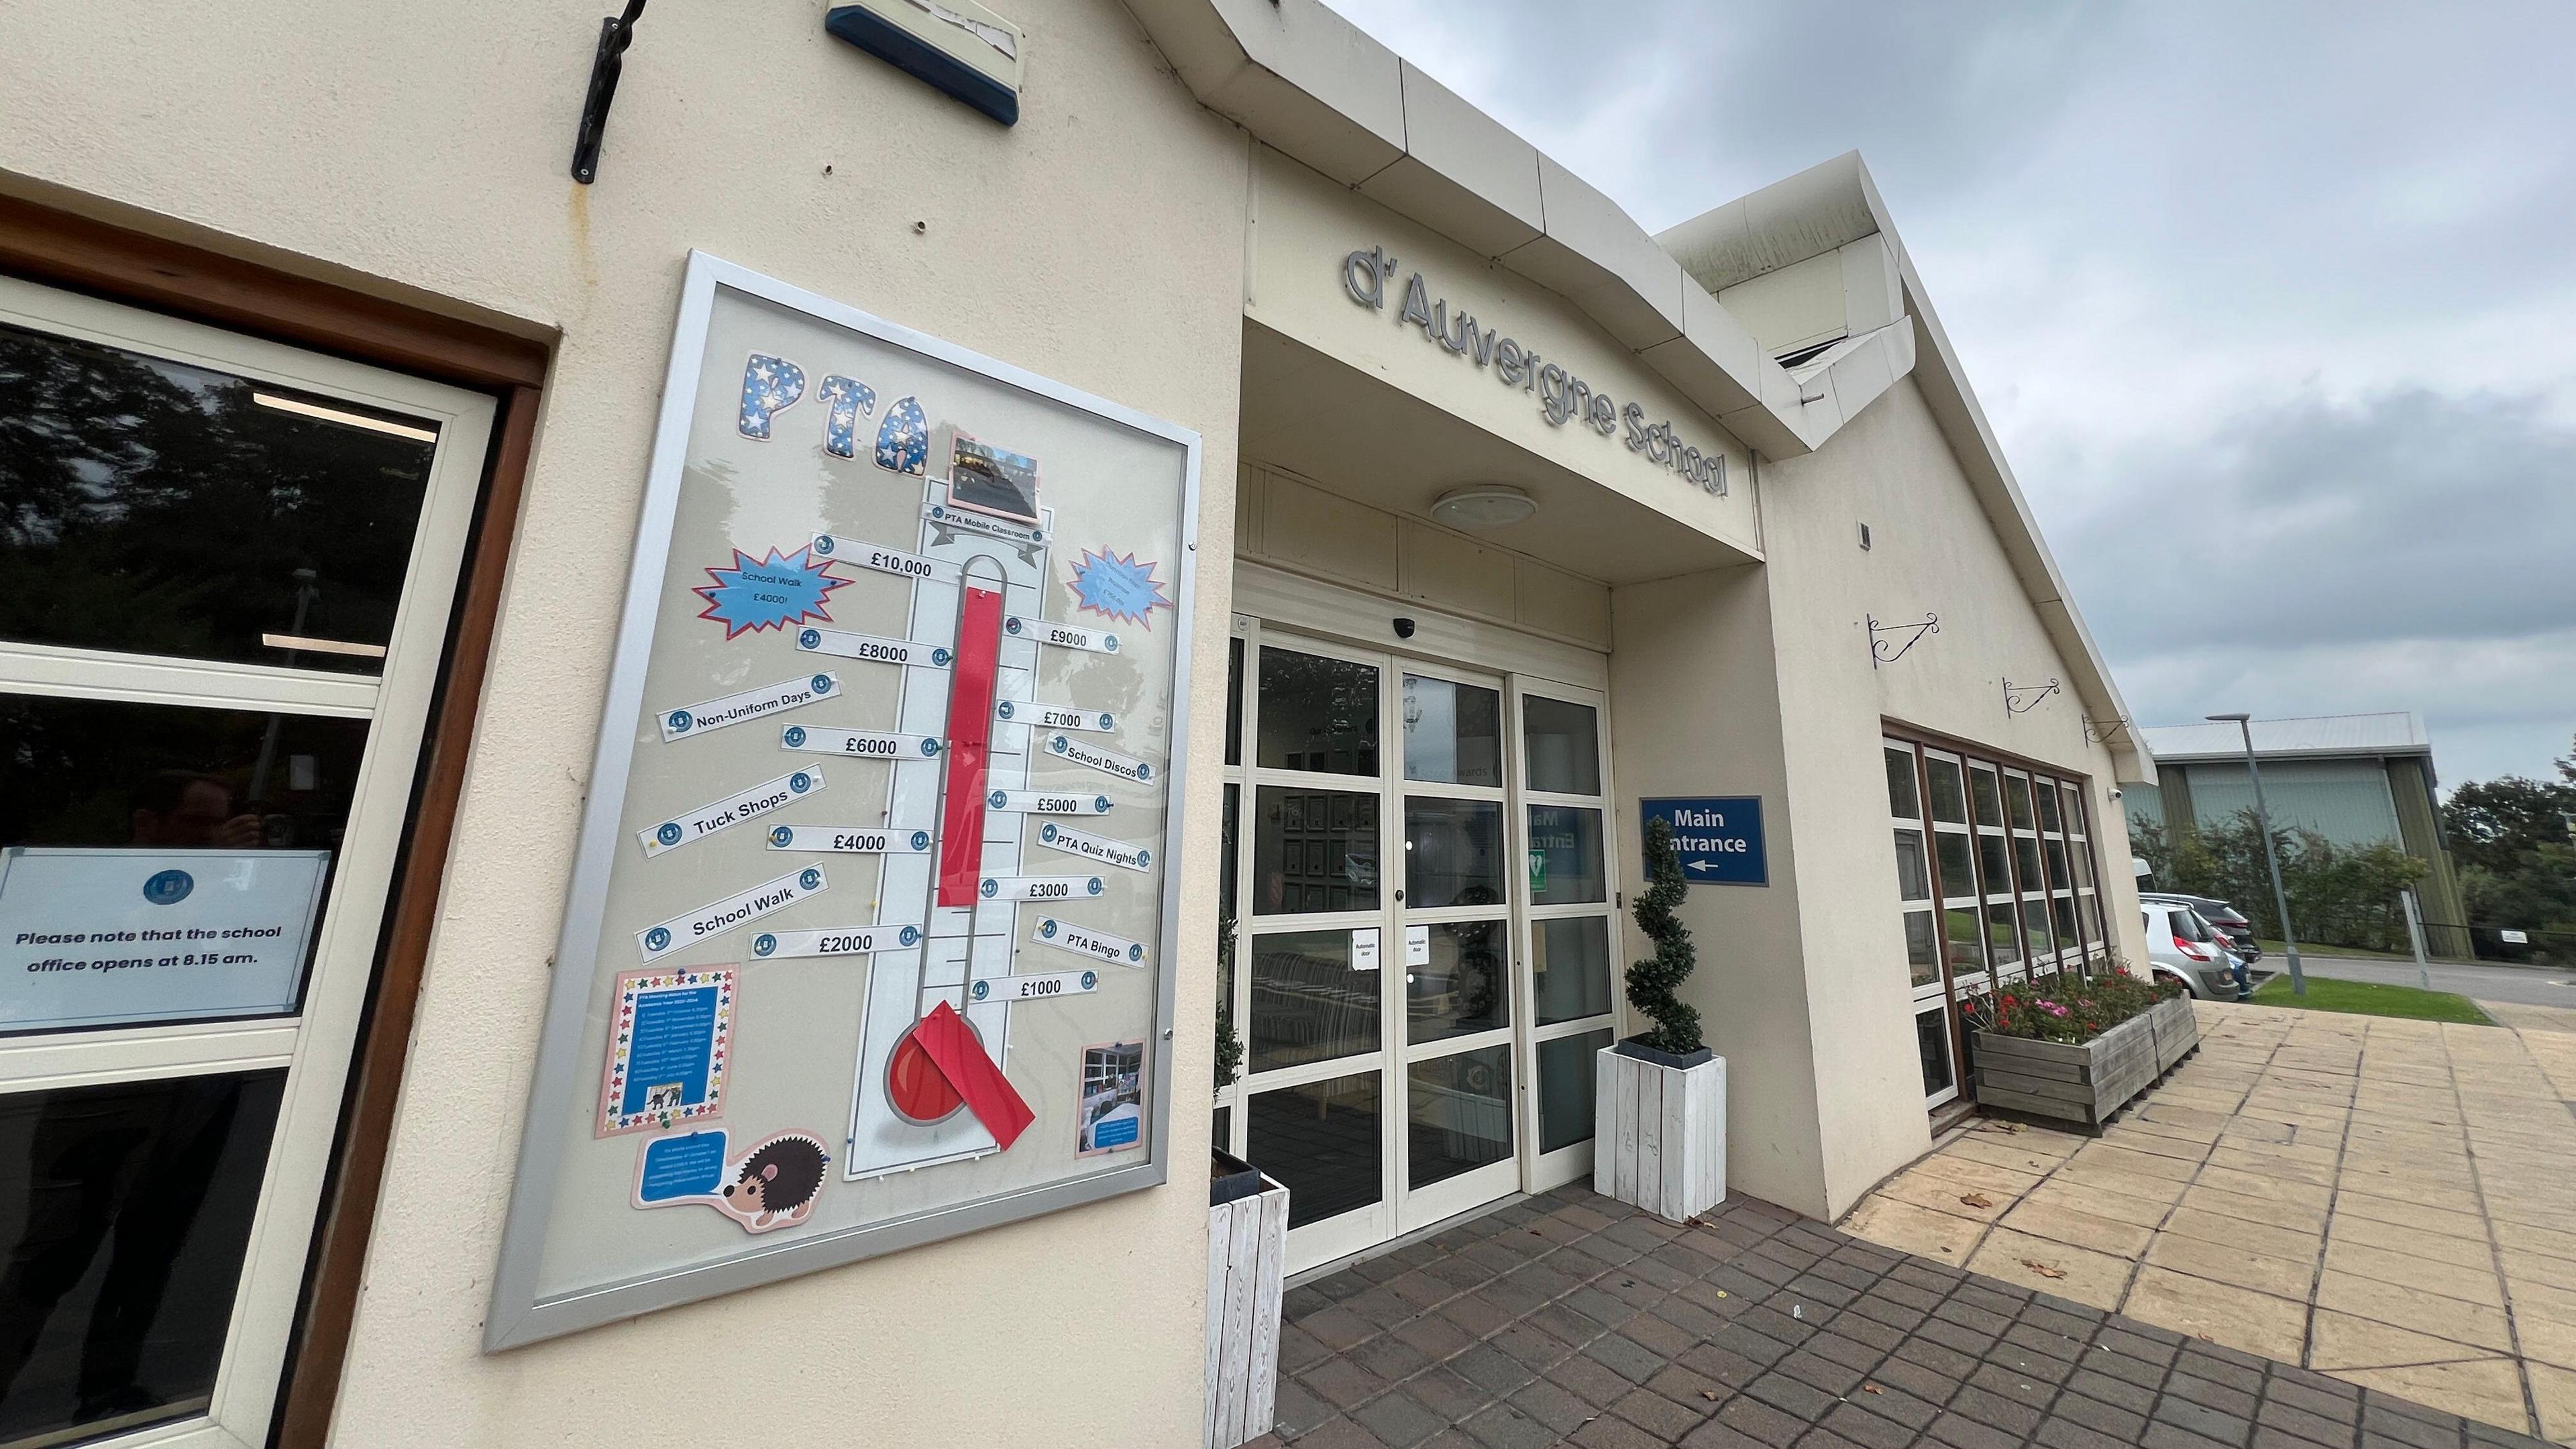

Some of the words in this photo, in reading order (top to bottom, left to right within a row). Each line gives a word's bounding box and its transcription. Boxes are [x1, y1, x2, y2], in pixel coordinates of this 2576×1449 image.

[738, 354, 928, 476] PTA
[1625, 402, 1729, 498] School
[945, 513, 962, 524] PTA
[964, 517, 990, 530] Mobile
[991, 525, 1030, 541] Classroom
[871, 552, 932, 577] £10,000
[741, 572, 775, 584] School
[778, 576, 803, 587] Walk
[753, 593, 788, 604] £4000!
[1051, 629, 1087, 647] £9000
[859, 643, 908, 662] £8000
[696, 698, 779, 729] Non-Uniform
[781, 690, 812, 705] Days
[1044, 712, 1081, 727] £7000
[845, 737, 897, 755] £6000
[1067, 747, 1103, 767] School
[1104, 759, 1136, 777] Discos
[693, 810, 736, 834] Tuck
[738, 790, 788, 817] Shops
[1037, 798, 1077, 812] £5000
[1674, 809, 1725, 827] Main
[833, 834, 885, 850] £4000
[1057, 835, 1079, 850] PTA
[1081, 841, 1104, 857] Quiz
[1106, 848, 1137, 865] Nights
[1669, 835, 1747, 853] ntrance
[1029, 883, 1069, 898] £3000
[692, 903, 752, 936] School
[754, 888, 794, 912] Walk
[15, 930, 86, 946] Please
[89, 930, 137, 944] note
[141, 928, 182, 942] that
[186, 927, 217, 940] the
[221, 926, 282, 939] school
[818, 934, 873, 953] £2000
[1067, 933, 1088, 949] PTA
[1090, 941, 1120, 959] Bingo
[27, 958, 87, 973] office
[91, 957, 153, 973] opens
[158, 955, 179, 967] at
[182, 953, 219, 966] 8.15
[221, 953, 258, 965] am.
[1021, 979, 1061, 997] £1000
